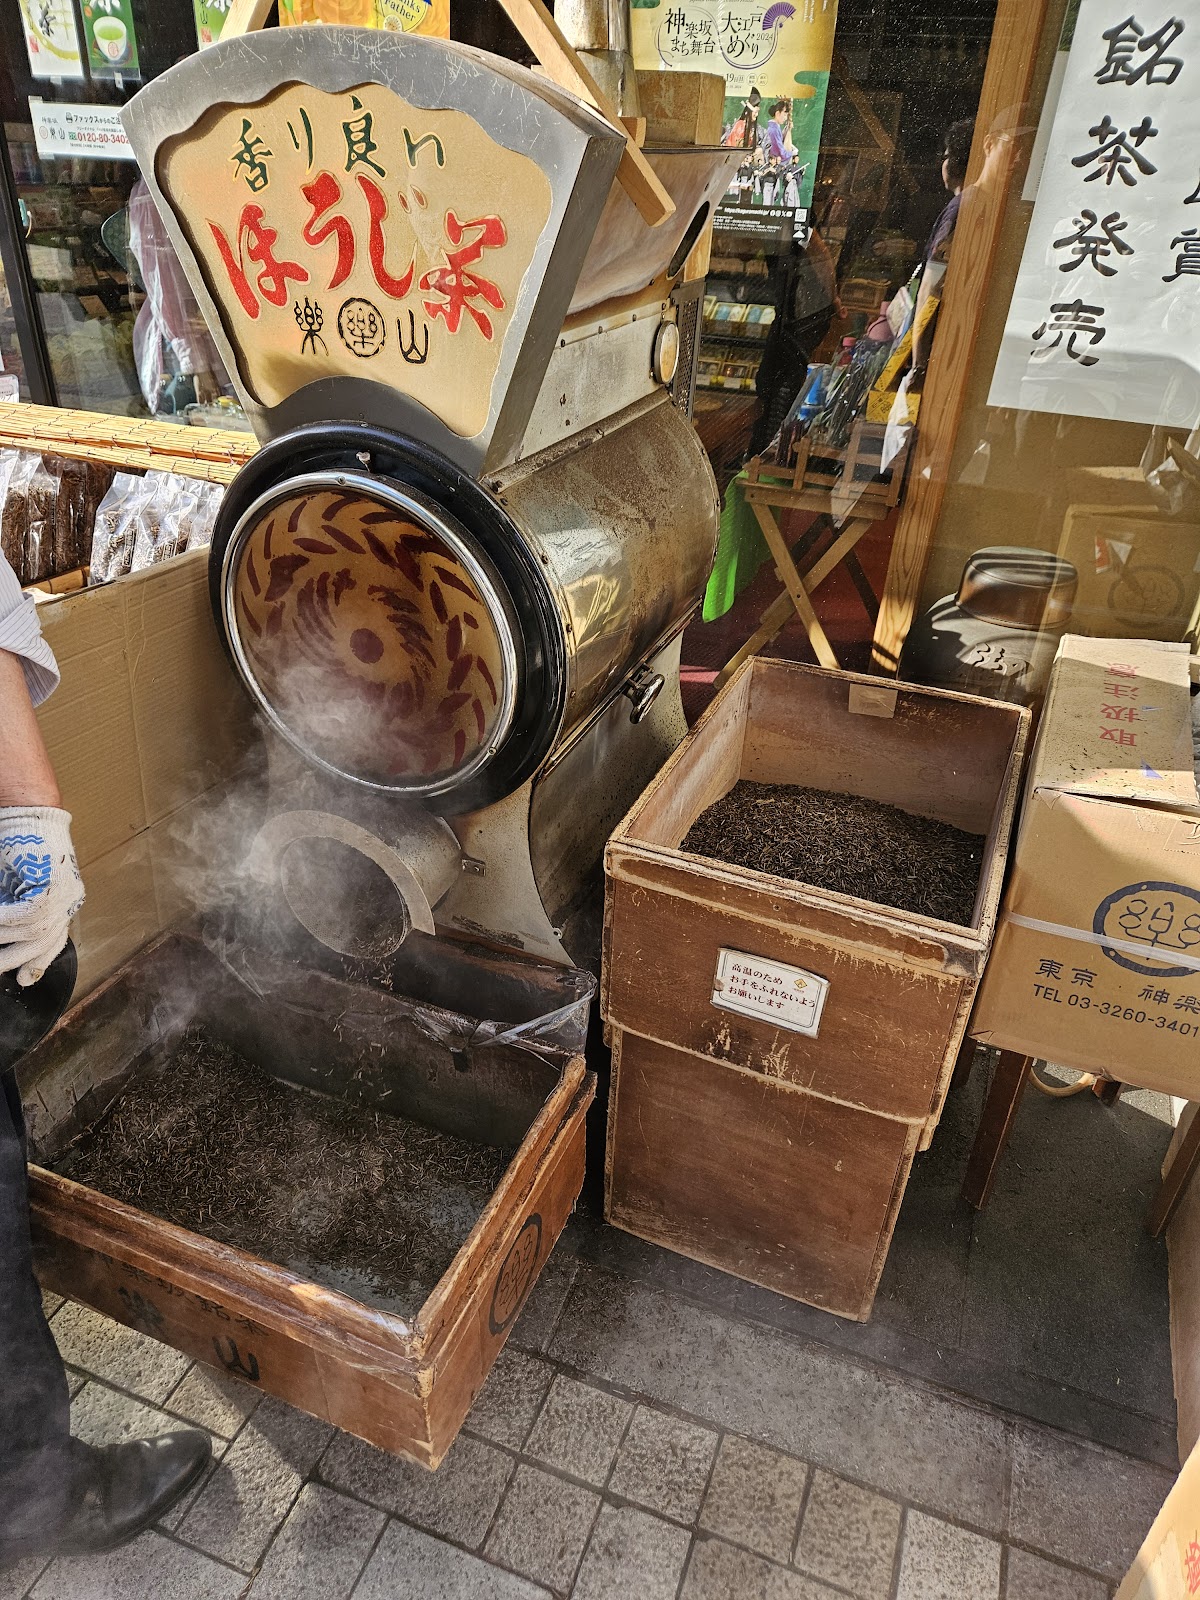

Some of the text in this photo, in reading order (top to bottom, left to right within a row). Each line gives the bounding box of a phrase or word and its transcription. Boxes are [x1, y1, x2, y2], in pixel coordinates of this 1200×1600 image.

[664, 7, 713, 39] 神楽坂
[721, 11, 763, 34] 大江戸
[756, 32, 774, 42] 2024
[671, 36, 716, 57] まち舞台
[727, 32, 759, 60] めぐり
[231, 94, 445, 193] 香り良い
[1031, 14, 1186, 367] 銘茶発売
[206, 171, 507, 341] ほうじ茶
[1098, 662, 1141, 748] 取扱注意
[731, 962, 783, 986] 高温のため
[728, 986, 785, 1010] お願いします
[730, 974, 816, 1009] お手をふれないよう
[1032, 983, 1200, 1038] TEL 03-3260-3401
